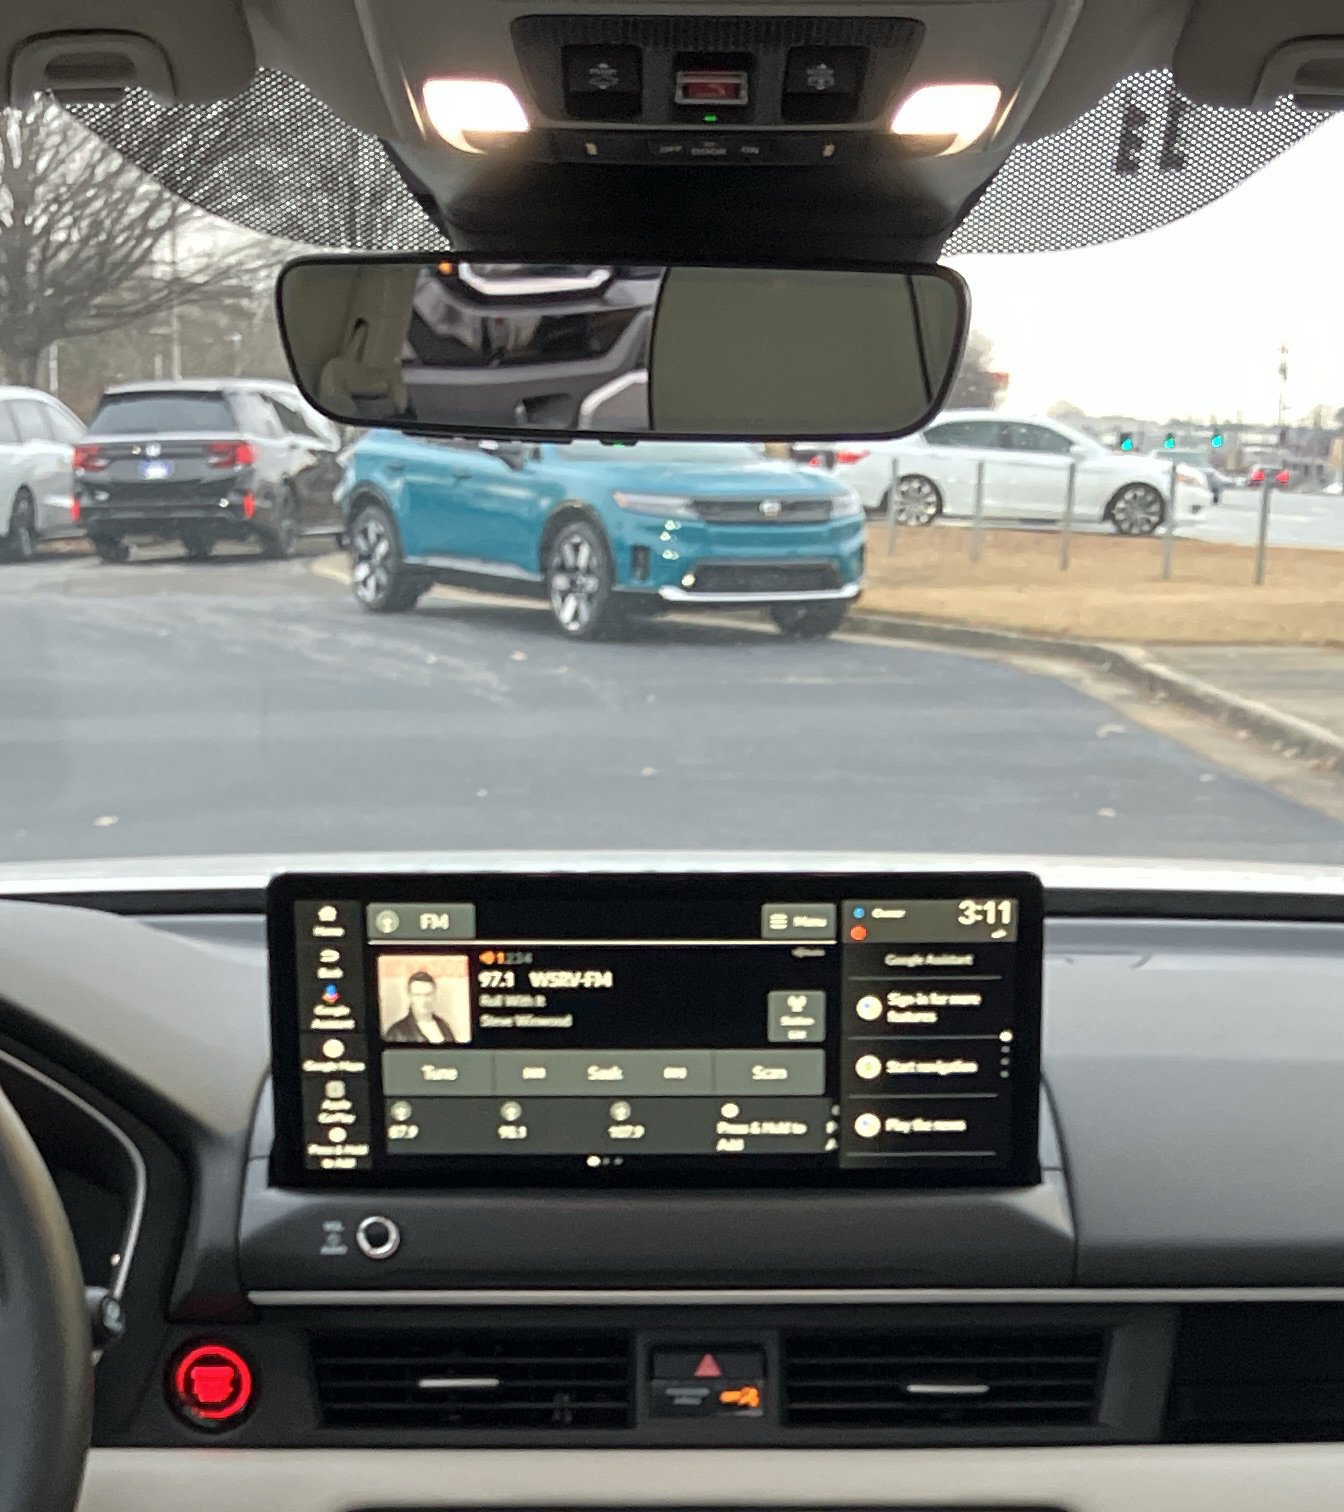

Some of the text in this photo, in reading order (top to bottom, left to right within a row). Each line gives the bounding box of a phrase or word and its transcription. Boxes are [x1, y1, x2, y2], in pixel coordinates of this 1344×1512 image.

[419, 913, 450, 929] FM
[957, 900, 1012, 925] 3:11
[478, 970, 515, 988] 97.1
[420, 1064, 459, 1081] Tune
[586, 1064, 625, 1081] Seek
[751, 1064, 788, 1081] Scan
